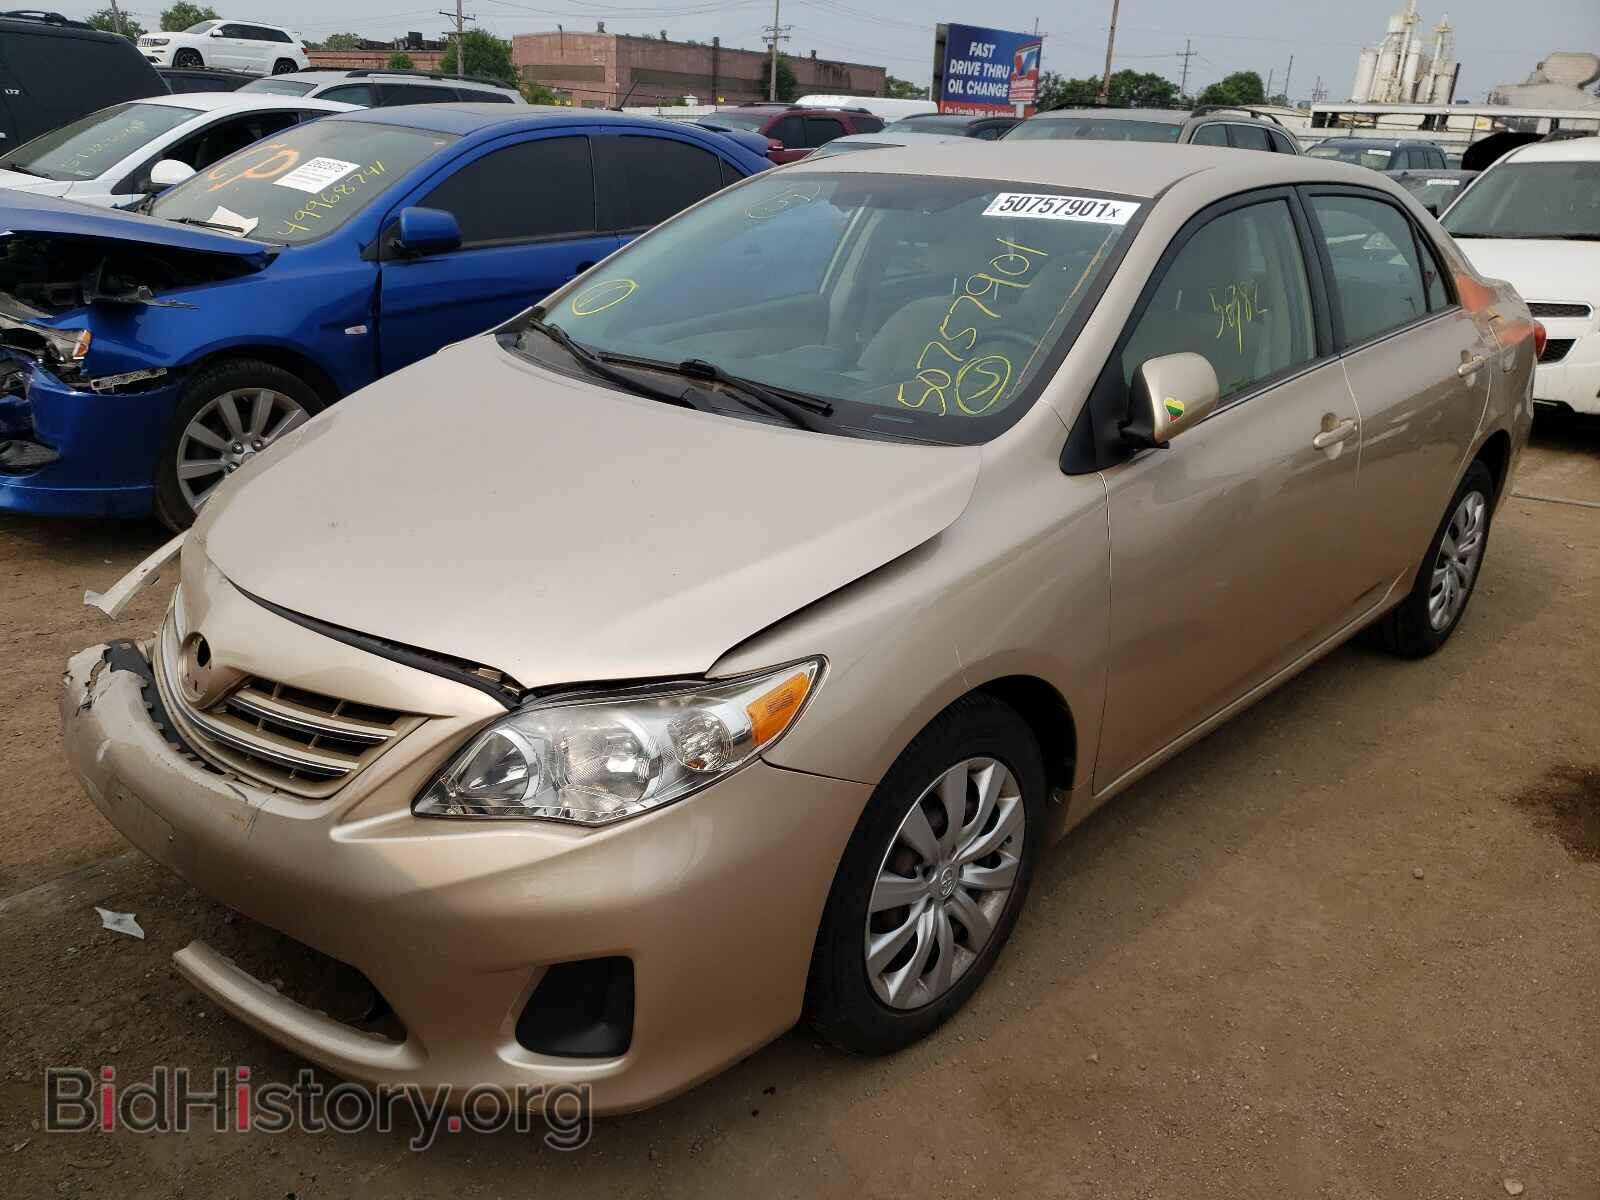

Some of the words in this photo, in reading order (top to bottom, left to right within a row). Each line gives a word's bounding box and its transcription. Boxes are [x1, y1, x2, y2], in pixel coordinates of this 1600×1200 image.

[969, 41, 996, 58] FAST
[949, 59, 982, 76] DRIVE
[983, 62, 1010, 79] THRU
[948, 79, 964, 94] OIL
[966, 81, 1009, 97] CHANGE
[897, 238, 1048, 416] 50757901
